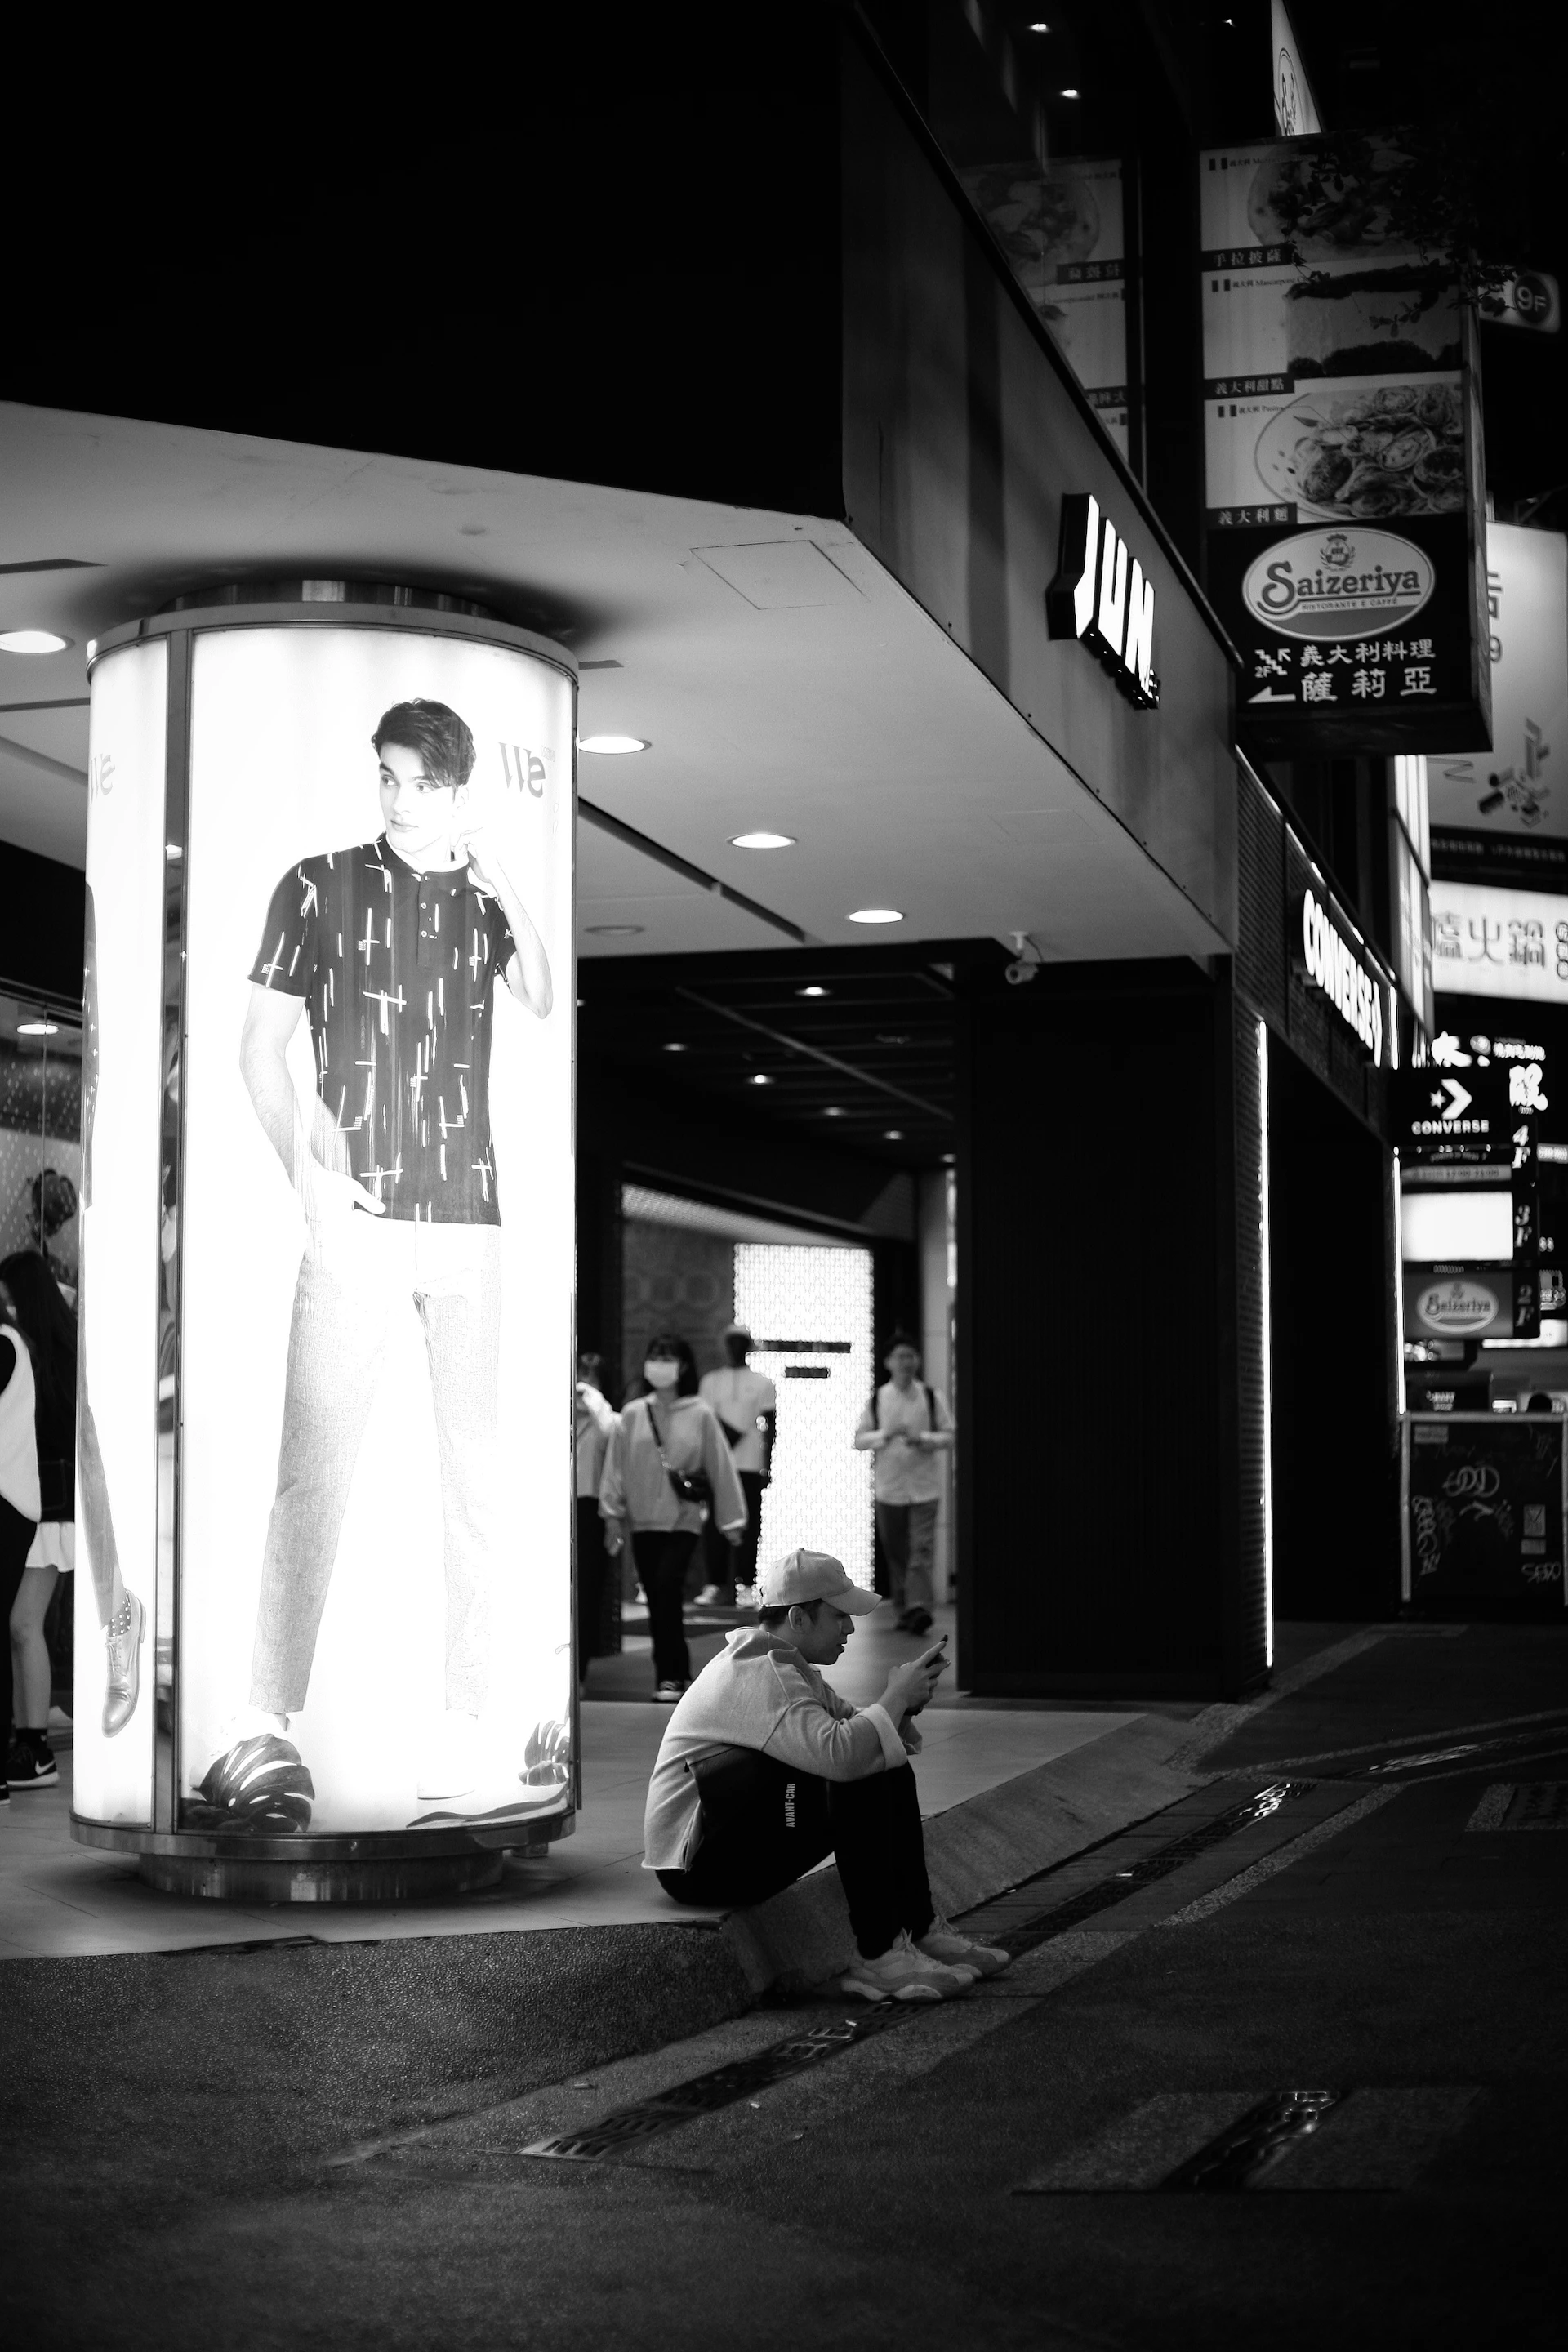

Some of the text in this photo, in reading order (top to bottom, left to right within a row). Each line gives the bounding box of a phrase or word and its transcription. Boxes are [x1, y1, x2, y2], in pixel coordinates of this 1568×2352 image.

[1517, 286, 1546, 312] 9F
[1260, 560, 1420, 609] Saizeriya
[1301, 599, 1356, 611] RISTORANTE
[1300, 639, 1436, 667] 義大利料理
[1254, 665, 1272, 678] 2F
[1301, 666, 1437, 703] 薩莉亞
[1303, 889, 1374, 1046] CONVERSE
[1411, 1120, 1490, 1135] CONVERSE
